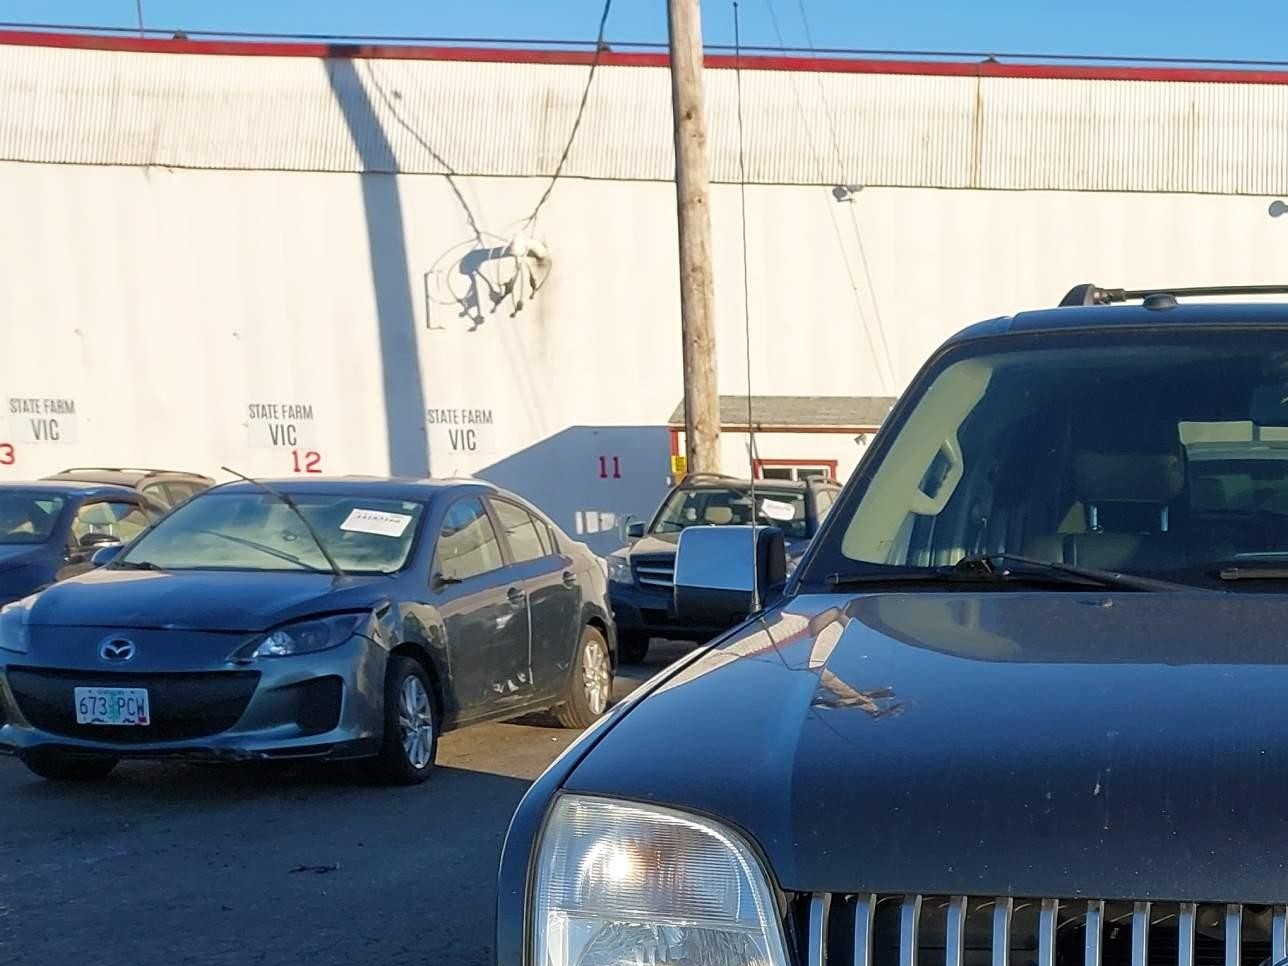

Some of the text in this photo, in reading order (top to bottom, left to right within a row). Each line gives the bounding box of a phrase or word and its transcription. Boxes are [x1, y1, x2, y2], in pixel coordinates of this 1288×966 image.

[10, 398, 76, 415] STATE FARM
[249, 403, 314, 420] STATE FARM
[428, 408, 494, 425] STATE FARM
[30, 418, 60, 441] VIC
[268, 423, 297, 446] VIC
[448, 428, 477, 452] VIC
[292, 450, 322, 473] 12
[599, 455, 621, 479] 11
[80, 696, 107, 716] 673
